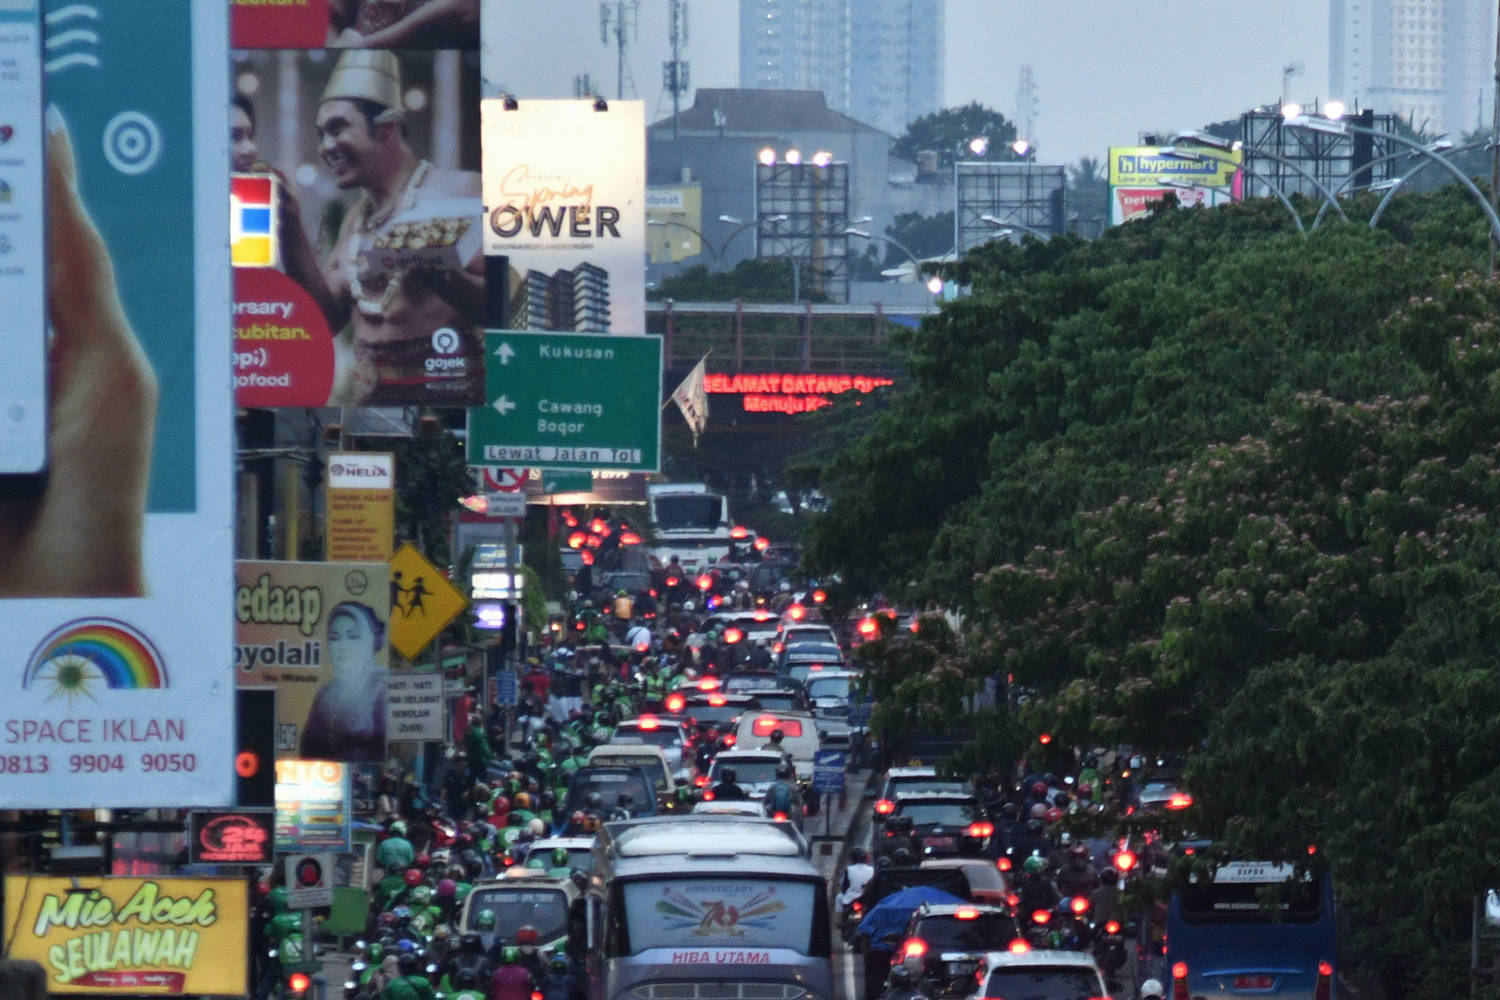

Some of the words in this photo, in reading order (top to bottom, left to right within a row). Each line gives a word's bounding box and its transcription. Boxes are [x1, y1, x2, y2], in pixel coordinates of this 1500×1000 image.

[1139, 157, 1215, 173] hypermart
[483, 206, 621, 238] OWER
[232, 324, 311, 340] ubitan.
[539, 344, 614, 360] Kukusan
[424, 357, 466, 371] gojek
[232, 373, 290, 388] ofood
[703, 374, 781, 393] SELAMAT
[538, 400, 603, 417] Cawang
[537, 419, 584, 435] Bogor
[488, 446, 541, 459] Lewat
[553, 447, 600, 461] Jalan
[611, 449, 636, 462] Tol
[235, 572, 321, 637] edaap
[5, 719, 92, 743] SPACE
[103, 718, 185, 742] IKLAN
[69, 754, 124, 773] 9904
[141, 753, 196, 772] 9050
[33, 890, 114, 938] Mie
[115, 881, 218, 927] Aceh
[48, 928, 200, 984] SEULAWAH
[672, 952, 710, 964] HIBA
[715, 952, 771, 964] UTAMA
